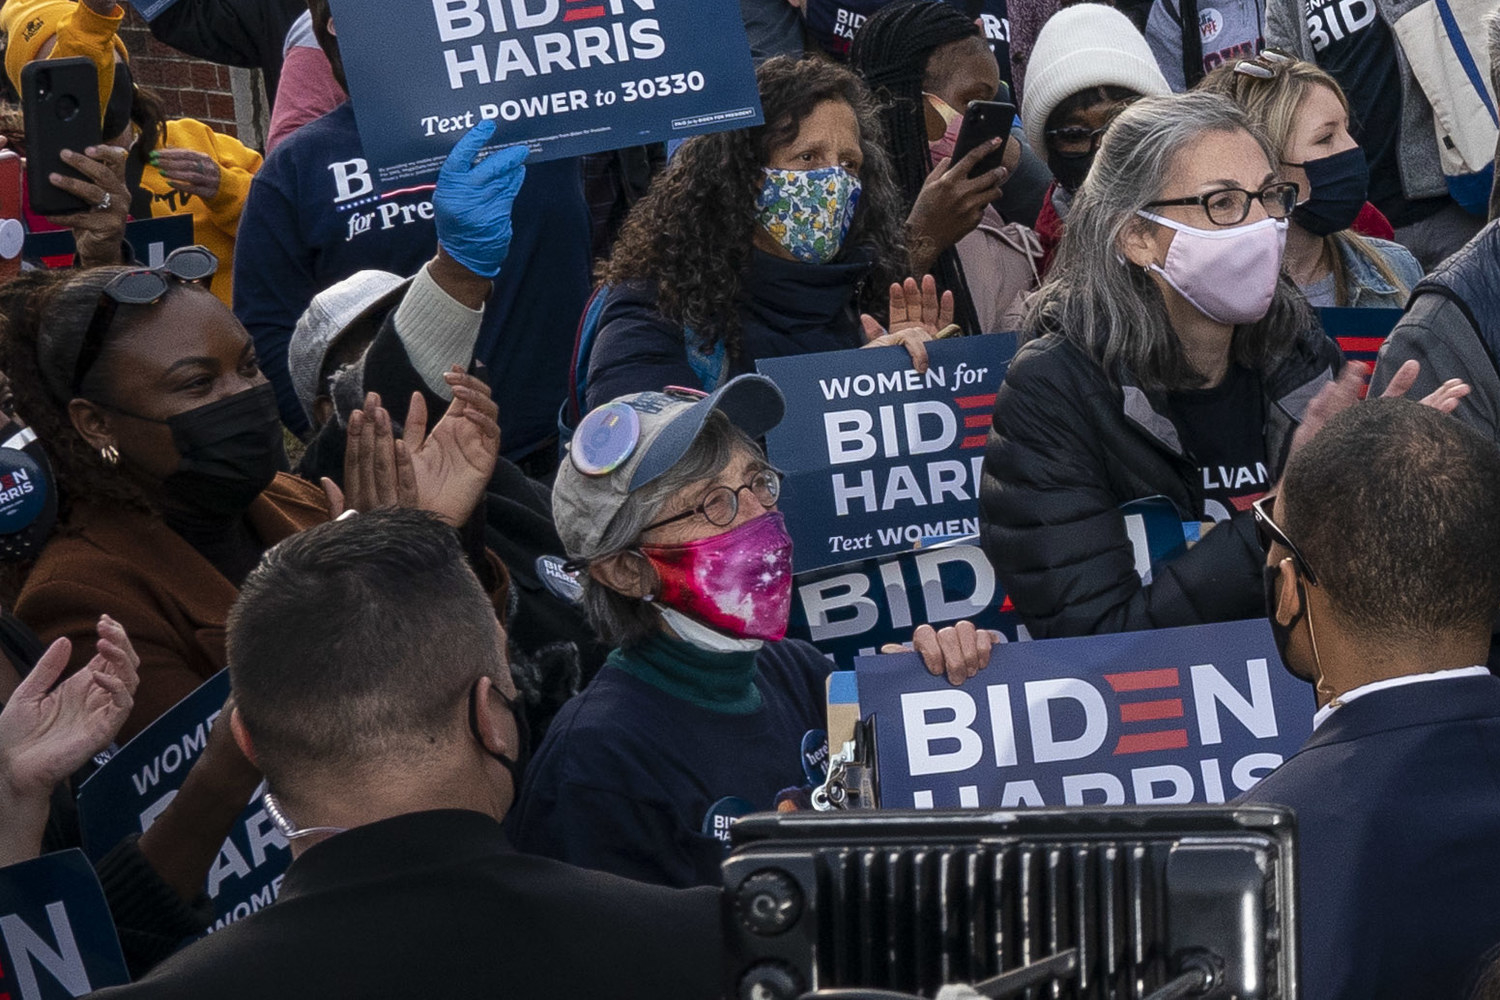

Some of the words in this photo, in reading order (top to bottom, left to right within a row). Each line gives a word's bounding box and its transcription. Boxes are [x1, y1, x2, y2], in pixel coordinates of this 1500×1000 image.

[836, 8, 868, 29] BID
[444, 18, 665, 90] HARRIS
[421, 111, 474, 137] Text
[480, 90, 588, 122] POWER
[595, 89, 616, 107] to
[622, 70, 705, 102] 30330
[345, 211, 376, 242] for
[819, 366, 946, 401] WOMEN
[951, 362, 988, 392] for
[823, 393, 998, 465] BIDE
[0, 480, 35, 505] RRIS
[831, 456, 985, 516] HAR
[828, 532, 873, 553] Text
[877, 517, 980, 547] WOMEN
[545, 567, 581, 588] HARR
[798, 544, 996, 642] BID
[900, 658, 1279, 776] BIDEN
[132, 708, 222, 797] WOM
